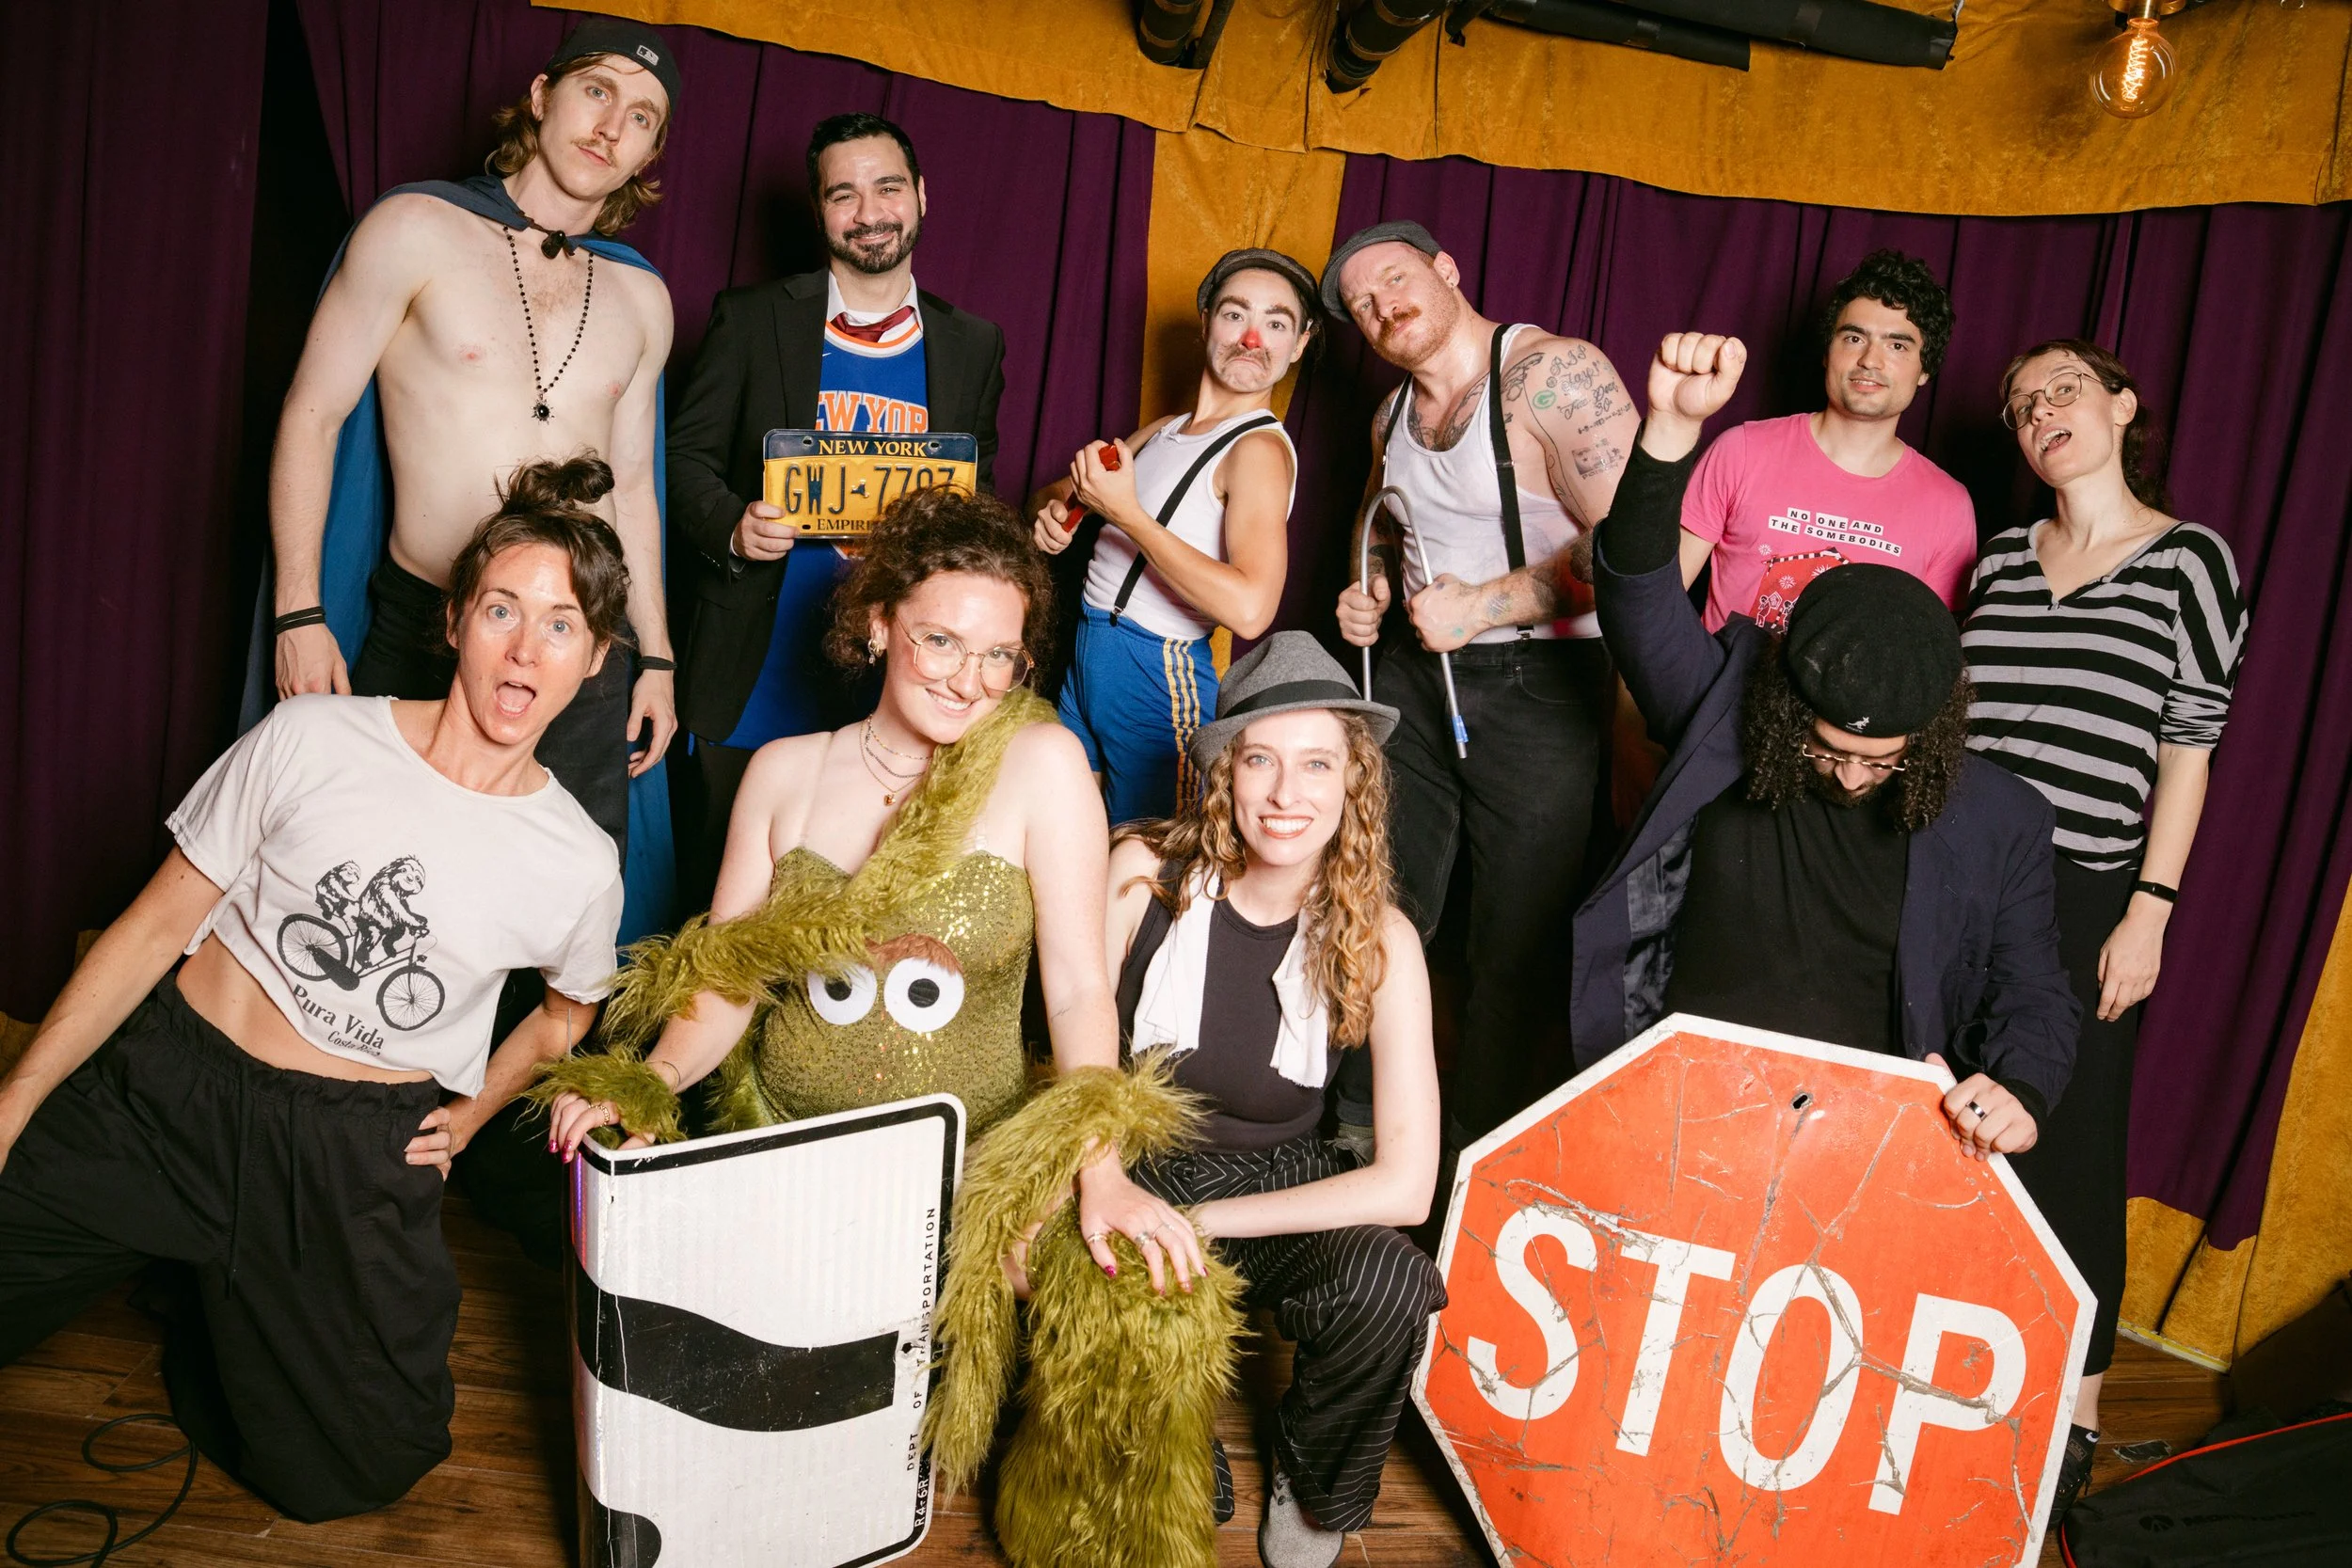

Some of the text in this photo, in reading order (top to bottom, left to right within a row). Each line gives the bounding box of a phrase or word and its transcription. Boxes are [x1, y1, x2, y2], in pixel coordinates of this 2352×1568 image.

[864, 393, 929, 433] YOR
[818, 440, 928, 457] NEW YORK
[785, 464, 846, 515] GWJ
[1772, 519, 1900, 554] THE SOMEBODIES
[1790, 510, 1882, 533] NO ONE AND
[293, 984, 385, 1050] Pura Vida
[327, 1030, 356, 1050] Costa
[1467, 1200, 2026, 1516] STOP
[907, 1433, 919, 1471] DEPT
[913, 1391, 923, 1409] OF
